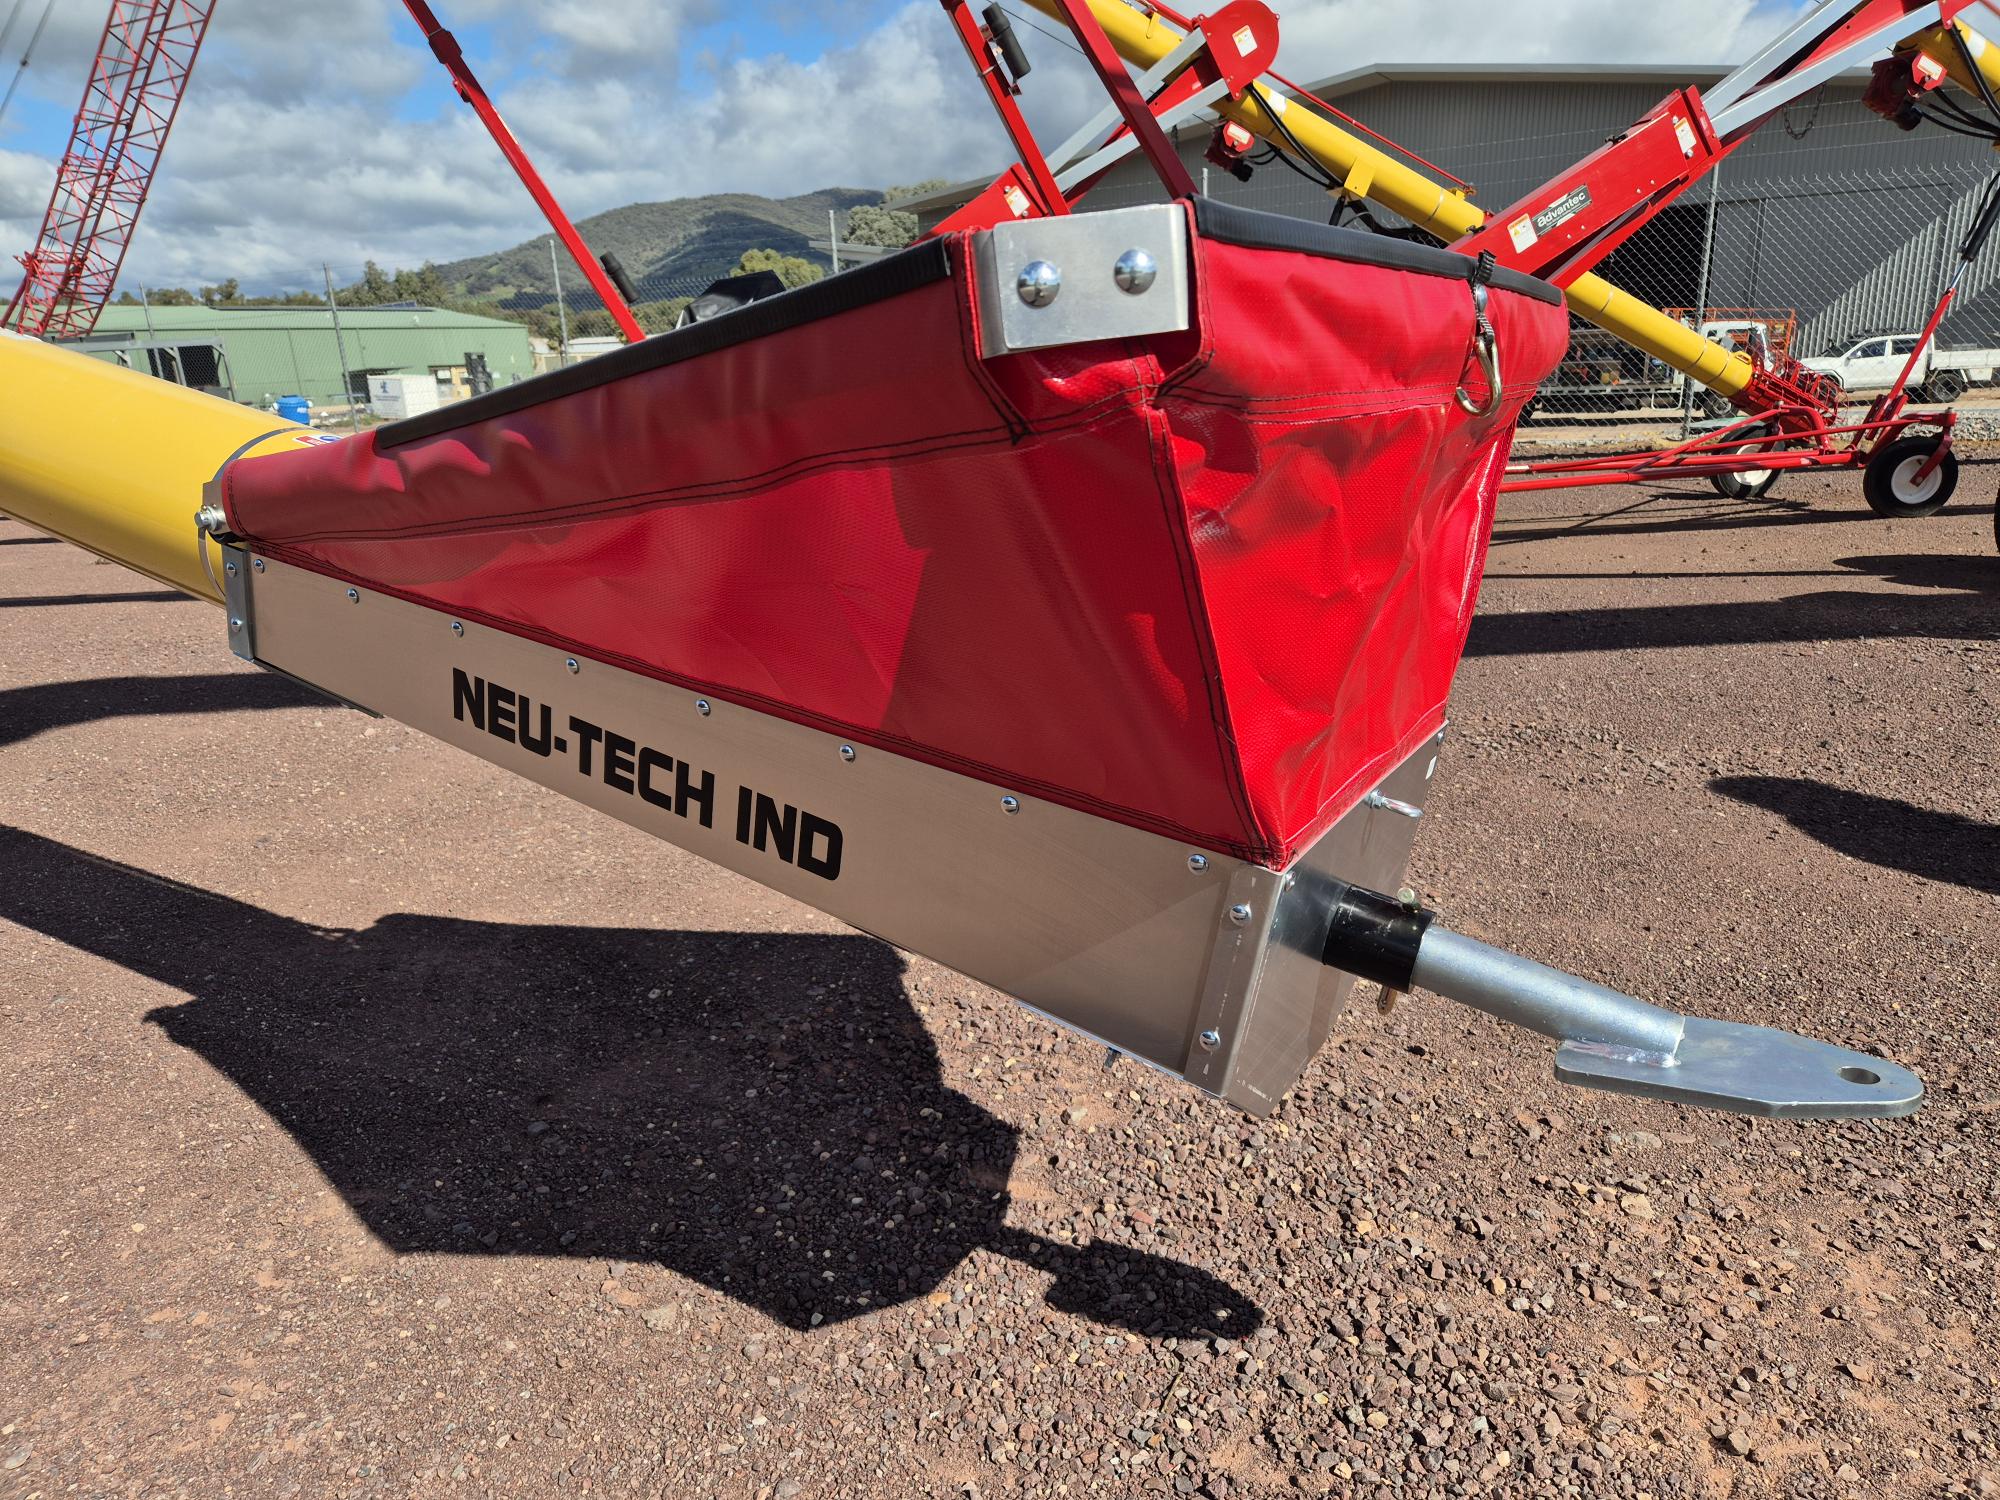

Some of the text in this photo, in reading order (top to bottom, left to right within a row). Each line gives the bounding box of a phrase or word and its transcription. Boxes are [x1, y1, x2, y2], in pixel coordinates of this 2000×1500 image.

[1537, 192, 1586, 227] advantec
[453, 667, 844, 881] NEU-TECH IND
